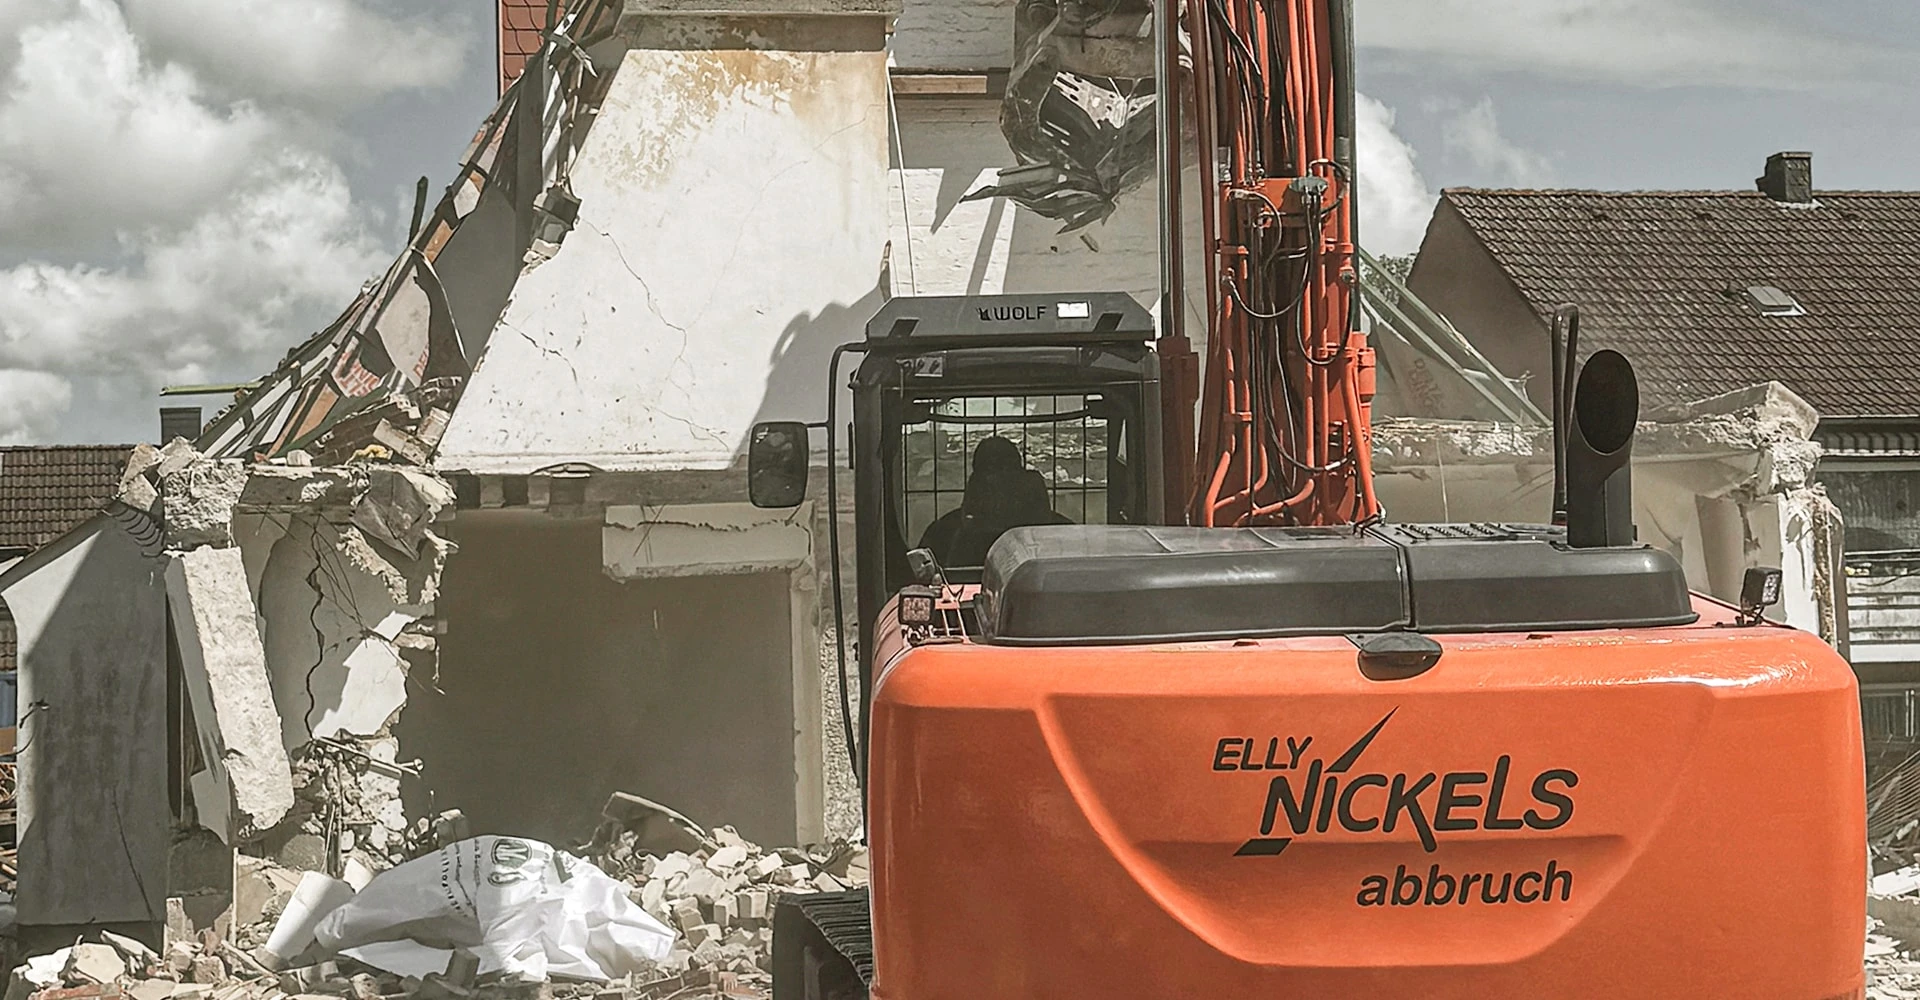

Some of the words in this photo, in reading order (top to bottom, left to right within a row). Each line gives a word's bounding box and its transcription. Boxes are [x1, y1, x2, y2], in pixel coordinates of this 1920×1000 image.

[994, 305, 1046, 321] WOLF
[1212, 736, 1313, 772] ELLY
[1259, 754, 1579, 853] NICKELS
[1356, 860, 1573, 906] abbruch
